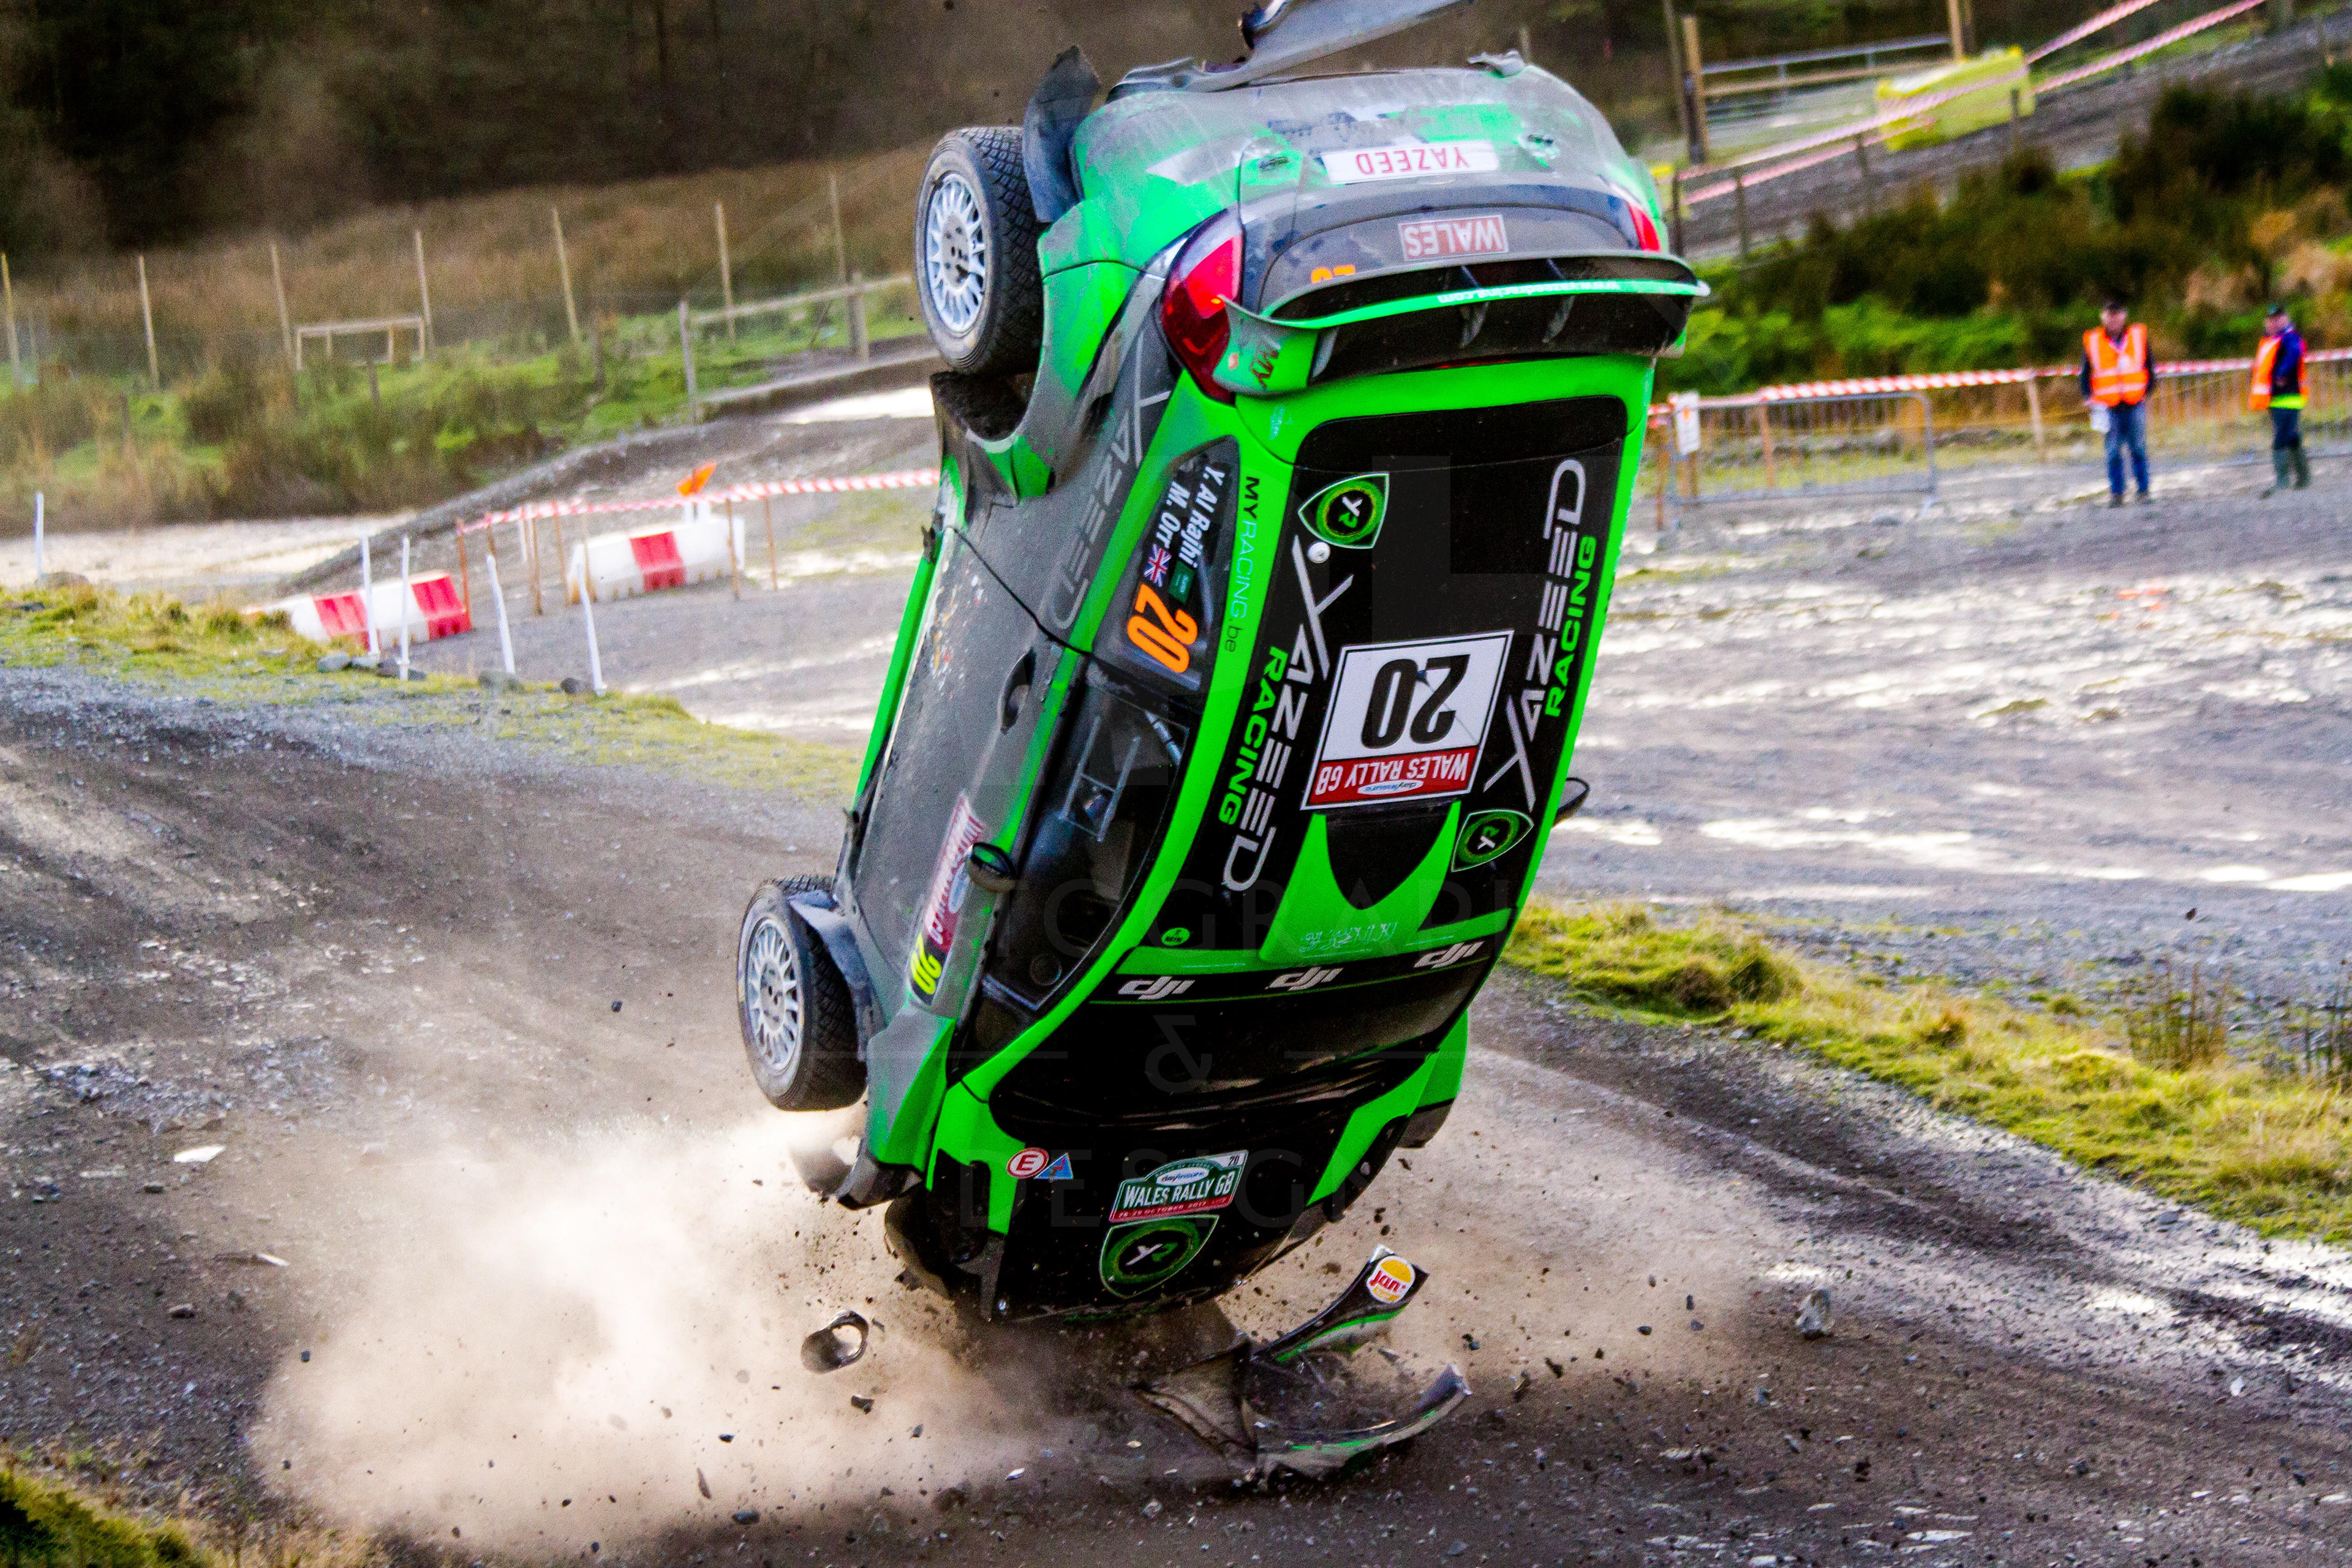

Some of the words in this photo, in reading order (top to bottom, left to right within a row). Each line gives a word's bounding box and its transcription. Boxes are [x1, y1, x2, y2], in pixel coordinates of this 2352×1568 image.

[1355, 146, 1470, 175] YAZEED
[1407, 218, 1504, 257] WALES
[1203, 466, 1226, 486] Y.
[1166, 481, 1190, 508] M.
[1195, 483, 1218, 513] Al
[1156, 512, 1181, 549] Orr
[1178, 510, 1212, 568] Rajhi
[1224, 477, 1259, 653] MYRACING.be
[1127, 584, 1199, 674] 20
[1485, 459, 1586, 811] YAZEED
[1545, 535, 1596, 717] RACING
[1223, 535, 1354, 892] YAZEED
[1361, 654, 1471, 749] 20
[1218, 647, 1287, 826] RACING
[1315, 766, 1343, 796] GB
[1344, 757, 1404, 788] RALLY
[1408, 752, 1469, 782] WALES
[1413, 941, 1485, 969] dji
[1118, 975, 1194, 1000] dji
[1265, 966, 1344, 991] dji
[1016, 1154, 1039, 1172] E
[1228, 1155, 1240, 1167] 20
[1122, 1185, 1170, 1209] WALES
[1171, 1178, 1216, 1204] RALLY
[1213, 1170, 1236, 1197] GB
